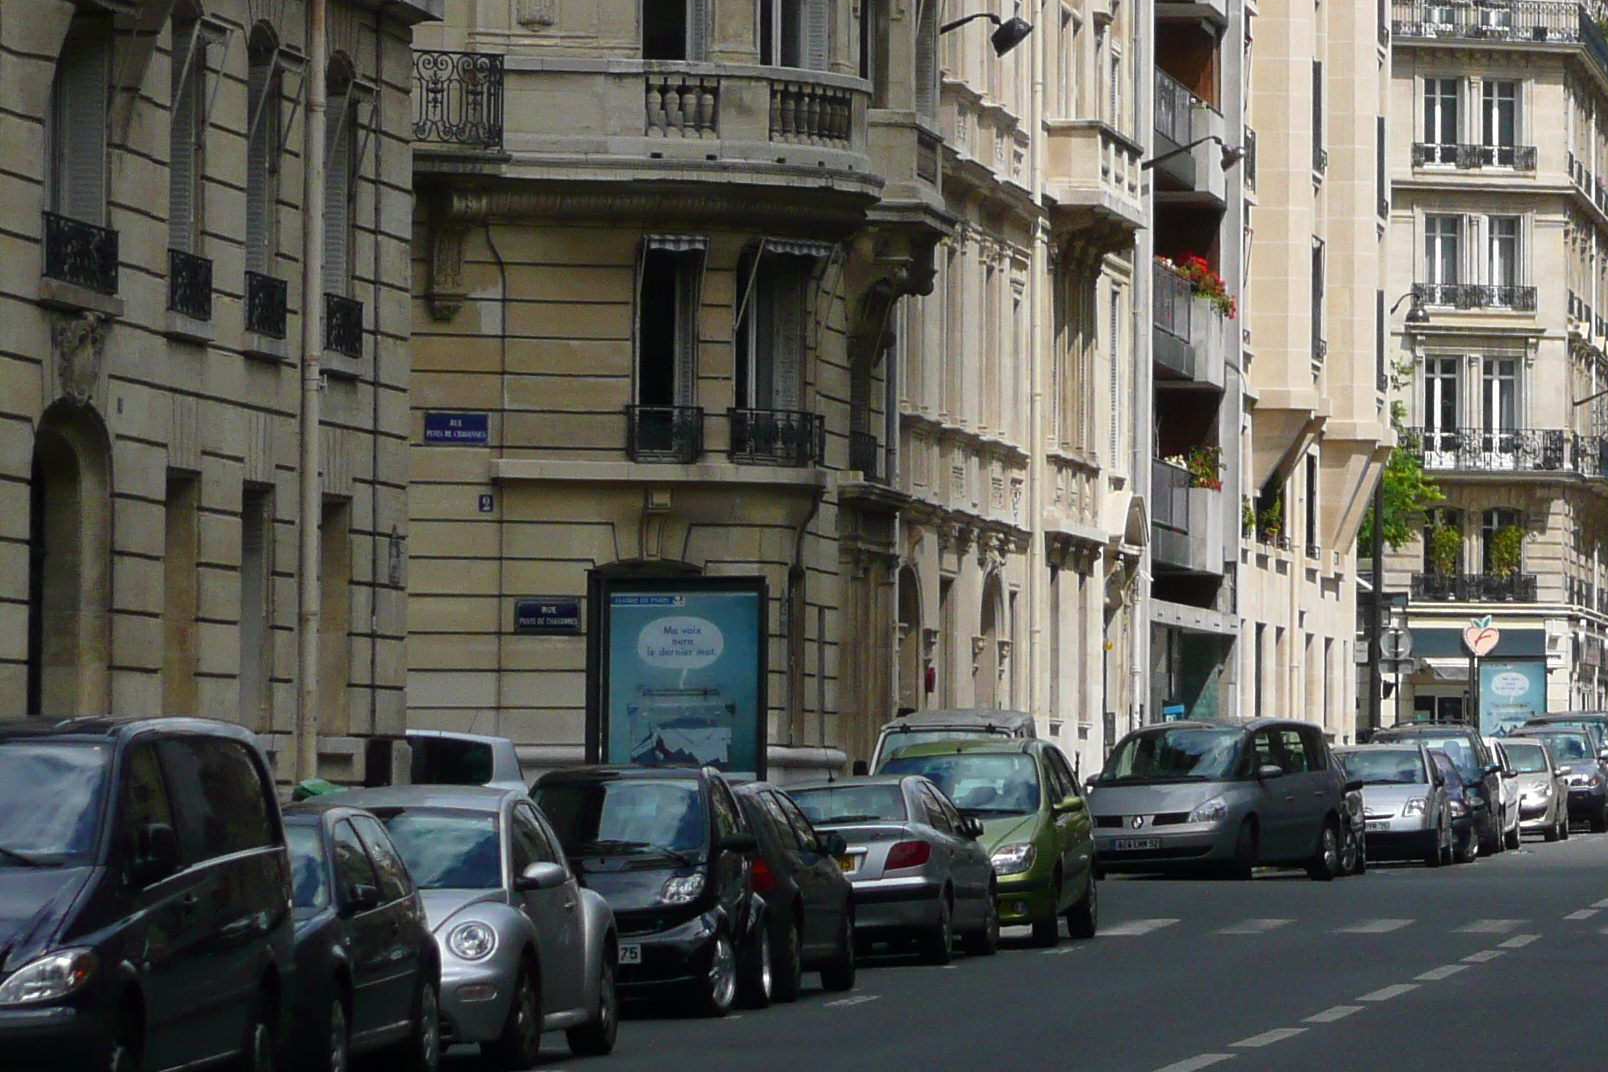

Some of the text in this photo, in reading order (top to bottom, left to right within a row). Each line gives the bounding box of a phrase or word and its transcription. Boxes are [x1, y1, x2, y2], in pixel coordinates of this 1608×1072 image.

[482, 496, 491, 511] 2
[541, 606, 557, 614] RUE
[663, 626, 702, 635] Ma voix
[671, 638, 694, 646] aura
[646, 646, 655, 656] le
[659, 647, 693, 656] dernier
[620, 946, 638, 961] 75
